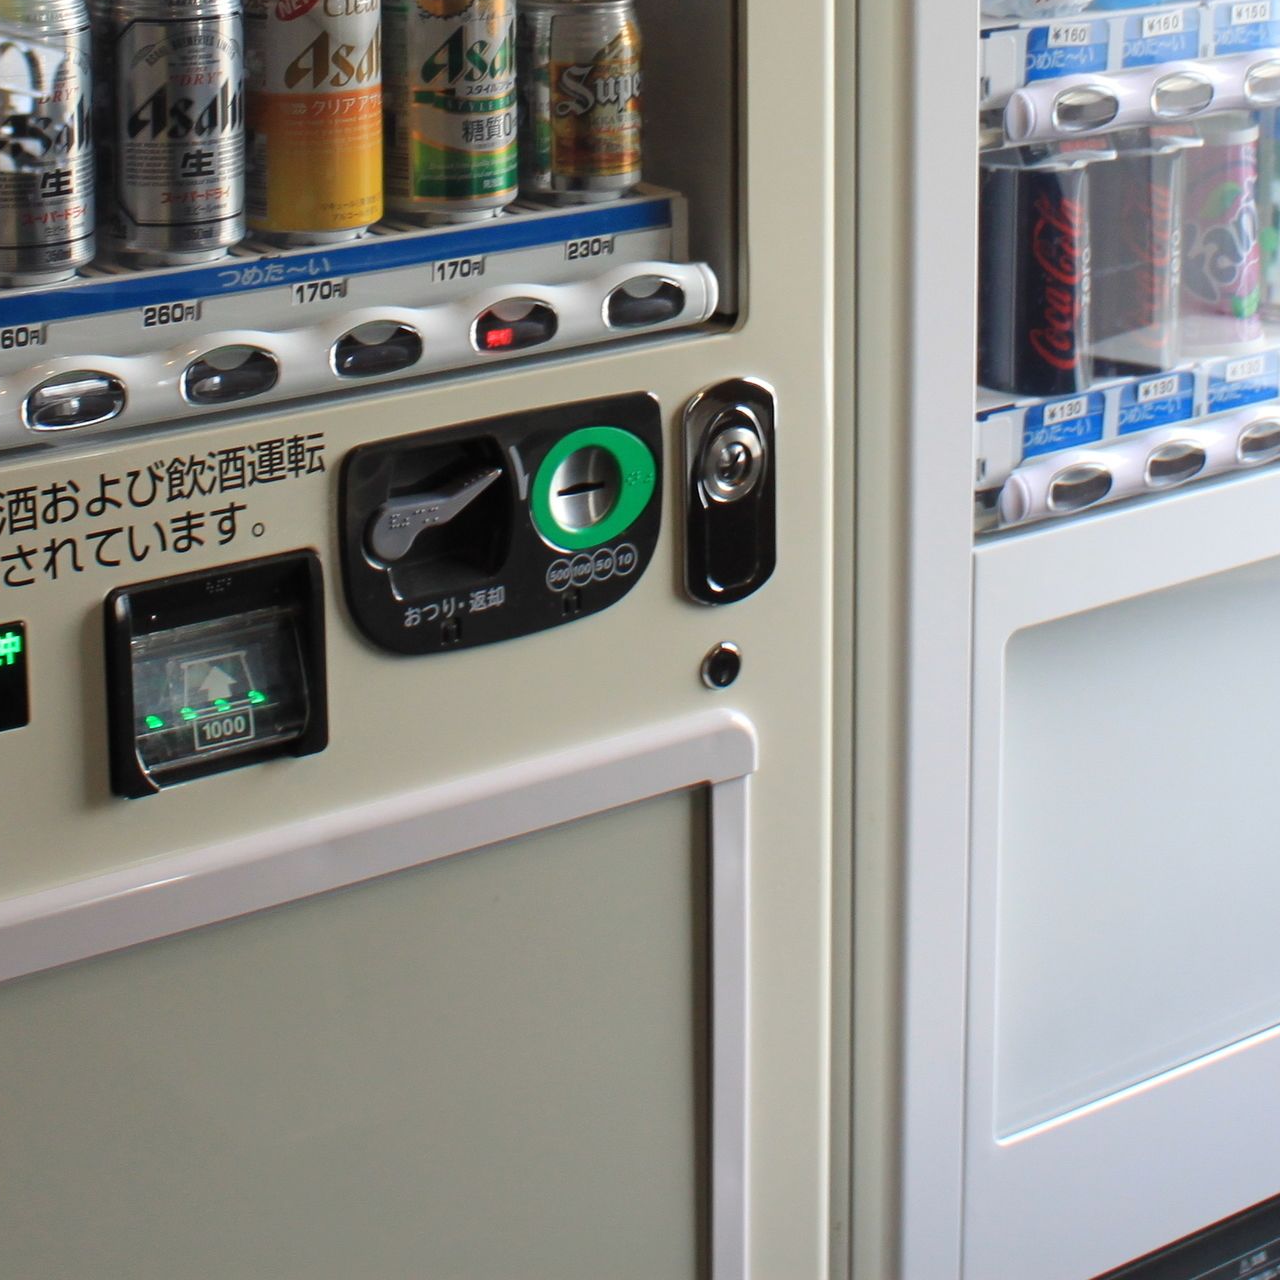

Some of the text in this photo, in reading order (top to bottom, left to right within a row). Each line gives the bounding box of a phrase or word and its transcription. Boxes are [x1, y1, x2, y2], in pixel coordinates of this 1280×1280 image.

[180, 149, 215, 178] 生
[39, 168, 74, 199] 生
[566, 237, 612, 260] 230円
[436, 259, 483, 280] 170円
[294, 282, 345, 304] 170円
[143, 302, 195, 326] 260円
[1048, 401, 1082, 420] ¥130
[595, 557, 613, 571] 50
[618, 552, 633, 566] 10
[403, 585, 506, 628] おつり・返却
[202, 715, 247, 739] 1000
